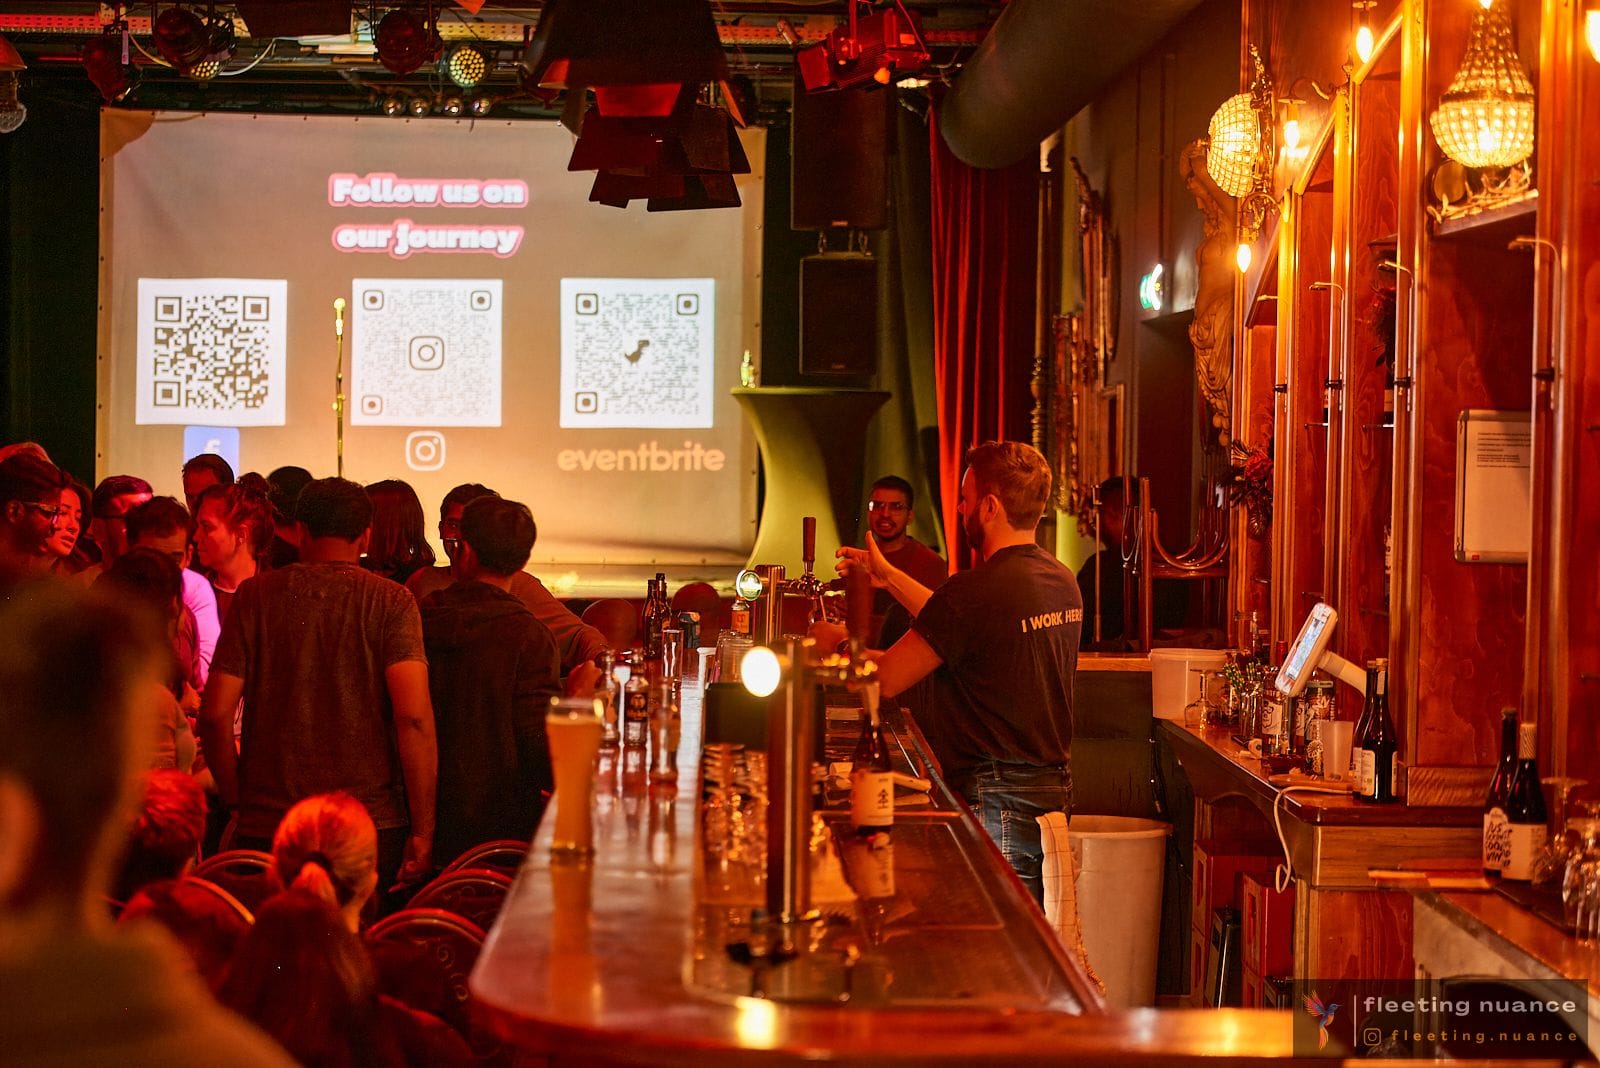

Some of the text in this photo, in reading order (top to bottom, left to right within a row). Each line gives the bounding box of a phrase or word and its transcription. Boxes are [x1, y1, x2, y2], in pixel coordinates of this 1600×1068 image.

[332, 176, 525, 204] Follow us on
[335, 228, 392, 249] our
[556, 440, 726, 472] eventbrite
[1021, 619, 1027, 633] I
[1029, 611, 1063, 630] WORK
